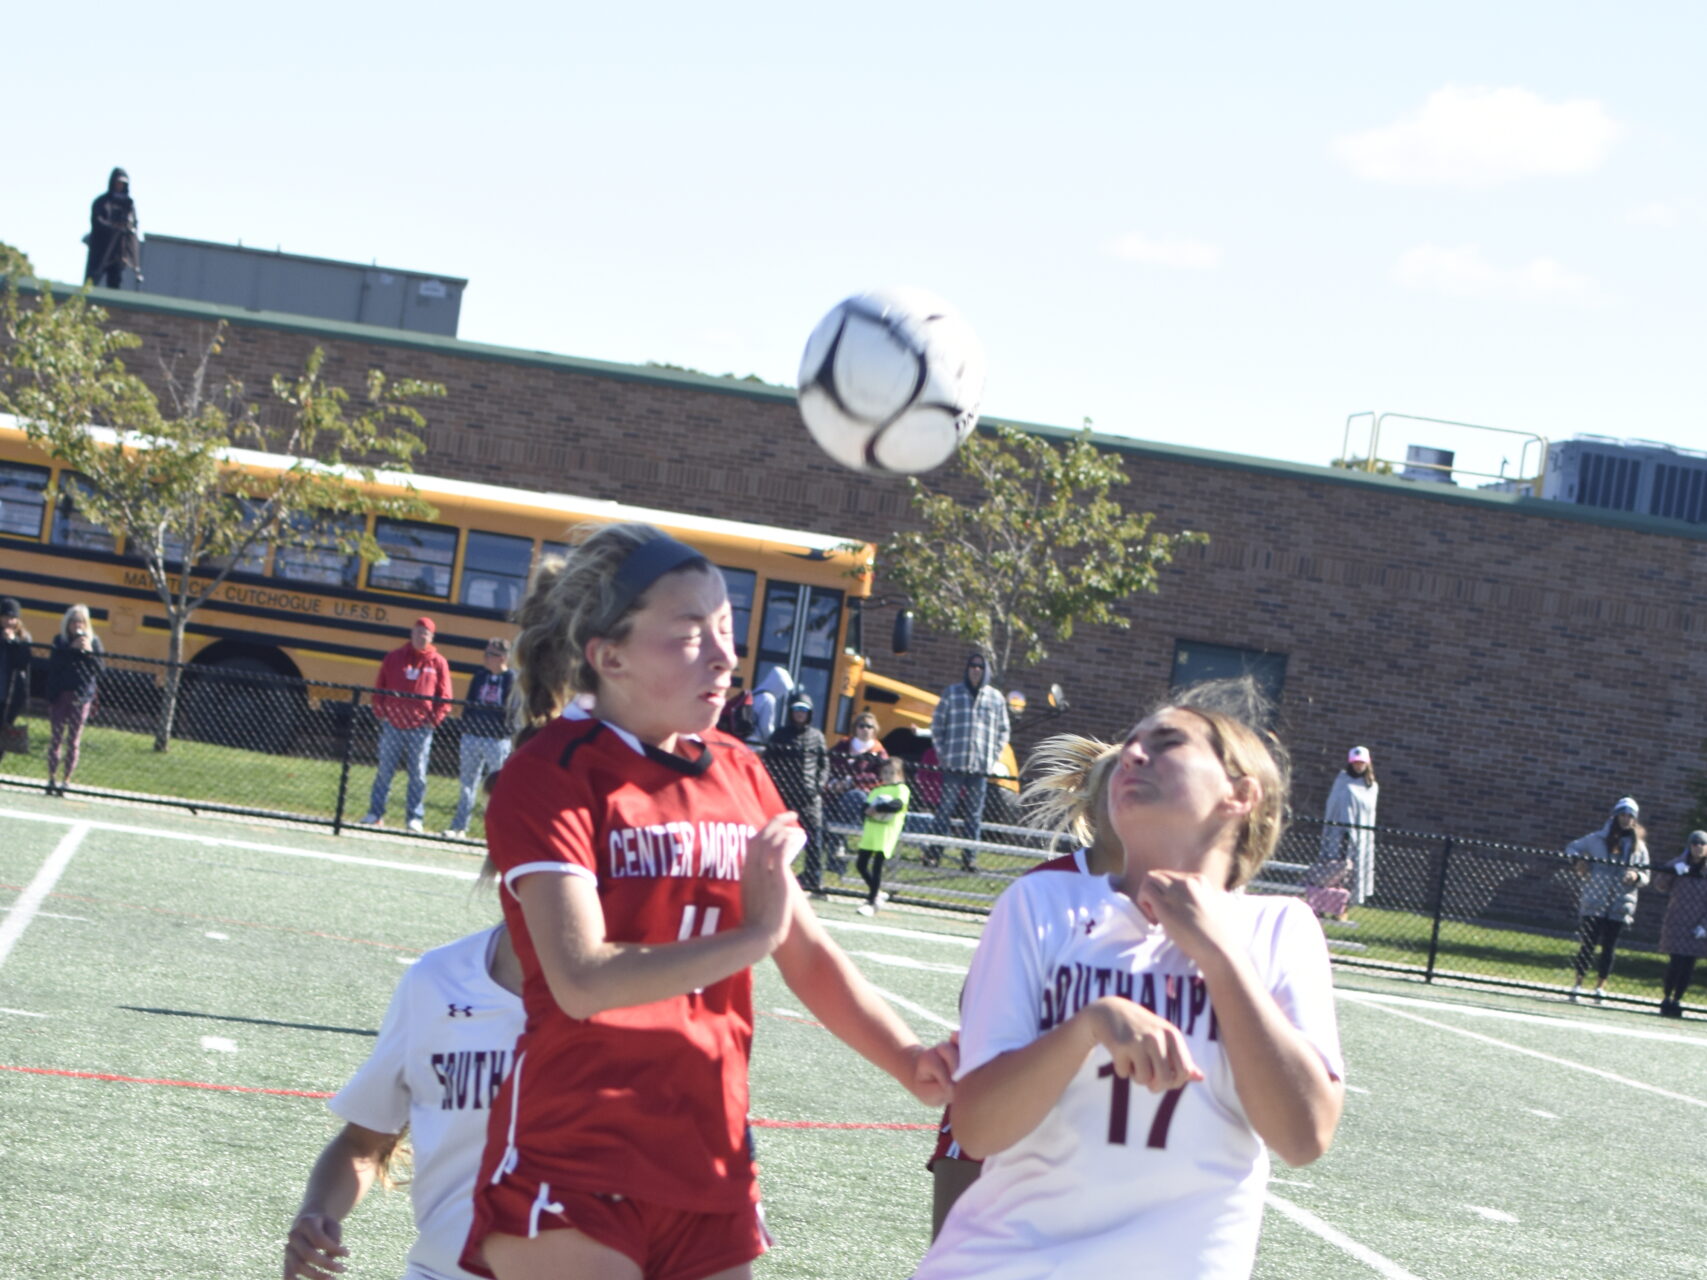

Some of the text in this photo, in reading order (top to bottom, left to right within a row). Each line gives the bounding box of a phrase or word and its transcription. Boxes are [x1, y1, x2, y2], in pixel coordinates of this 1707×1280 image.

[225, 586, 322, 613] CUTCHOGUE
[334, 602, 389, 623] U.F.S.D.
[609, 821, 694, 879] CENTER
[1098, 1061, 1188, 1149] 17
